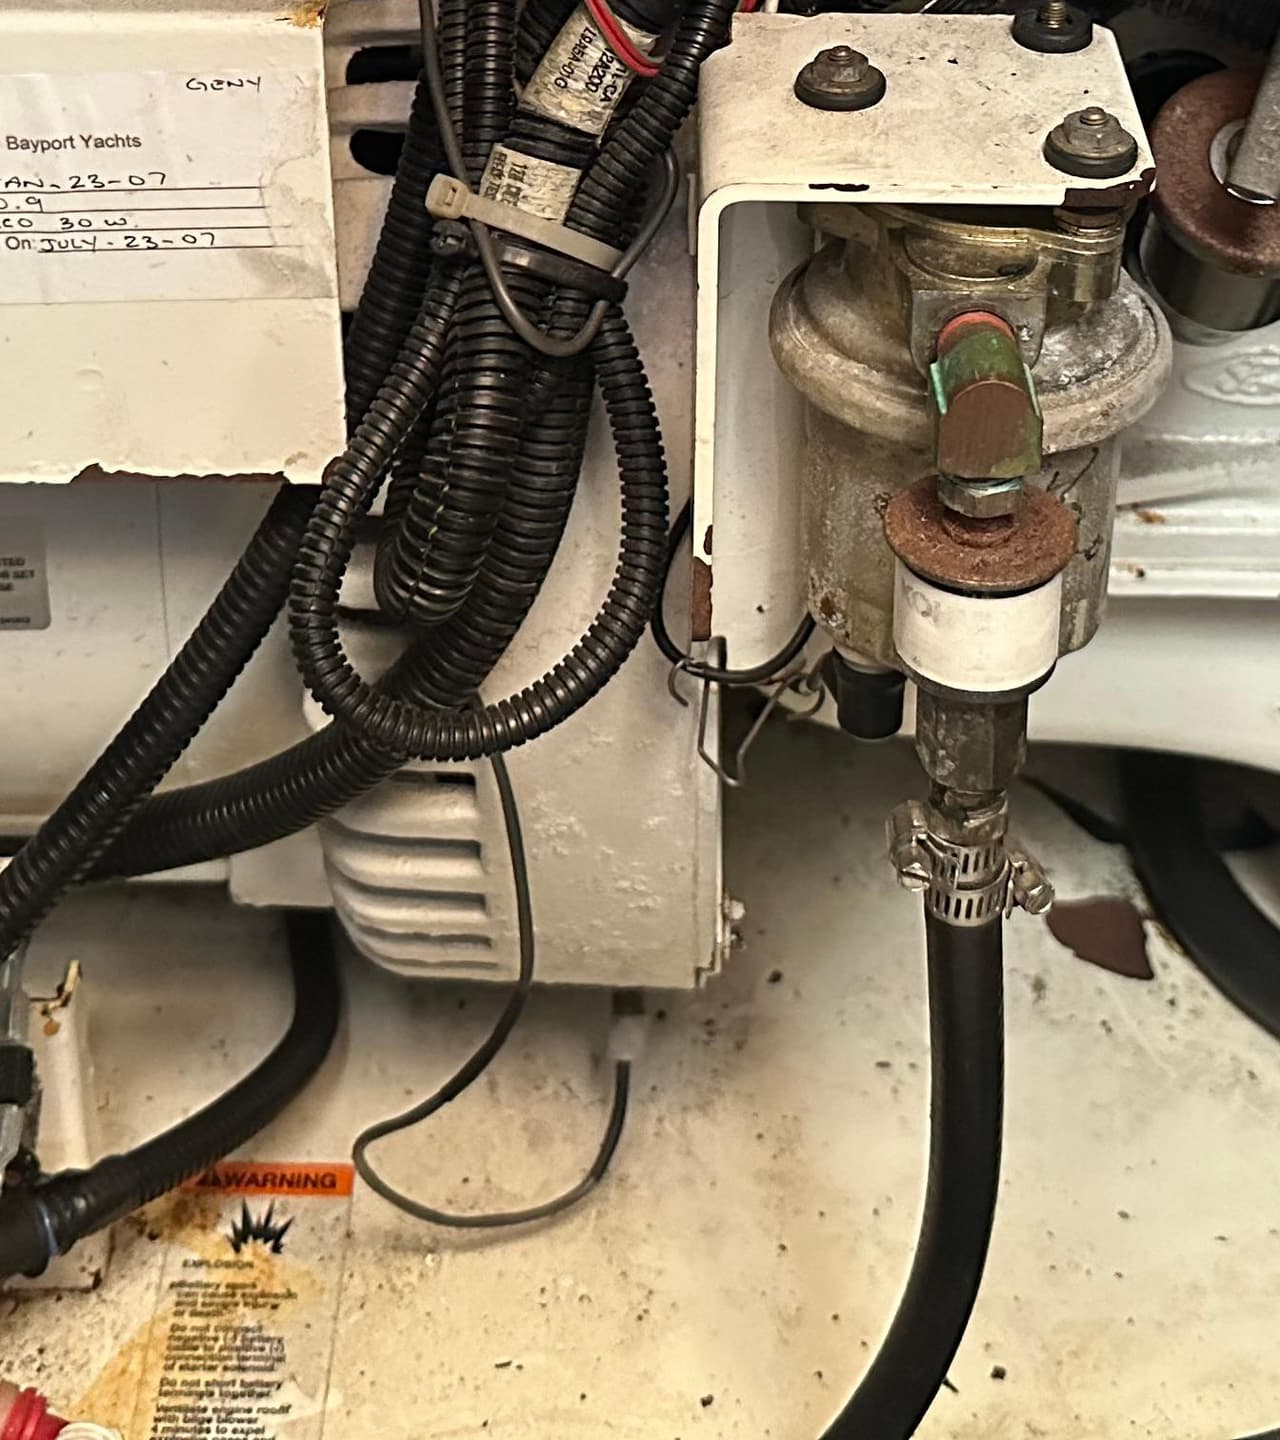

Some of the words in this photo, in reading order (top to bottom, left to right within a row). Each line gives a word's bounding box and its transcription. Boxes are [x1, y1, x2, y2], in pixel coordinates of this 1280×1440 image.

[6, 135, 75, 153] Bayport
[80, 133, 142, 150] Yachts
[5, 236, 36, 251] On:
[221, 1172, 338, 1190] WARNING
